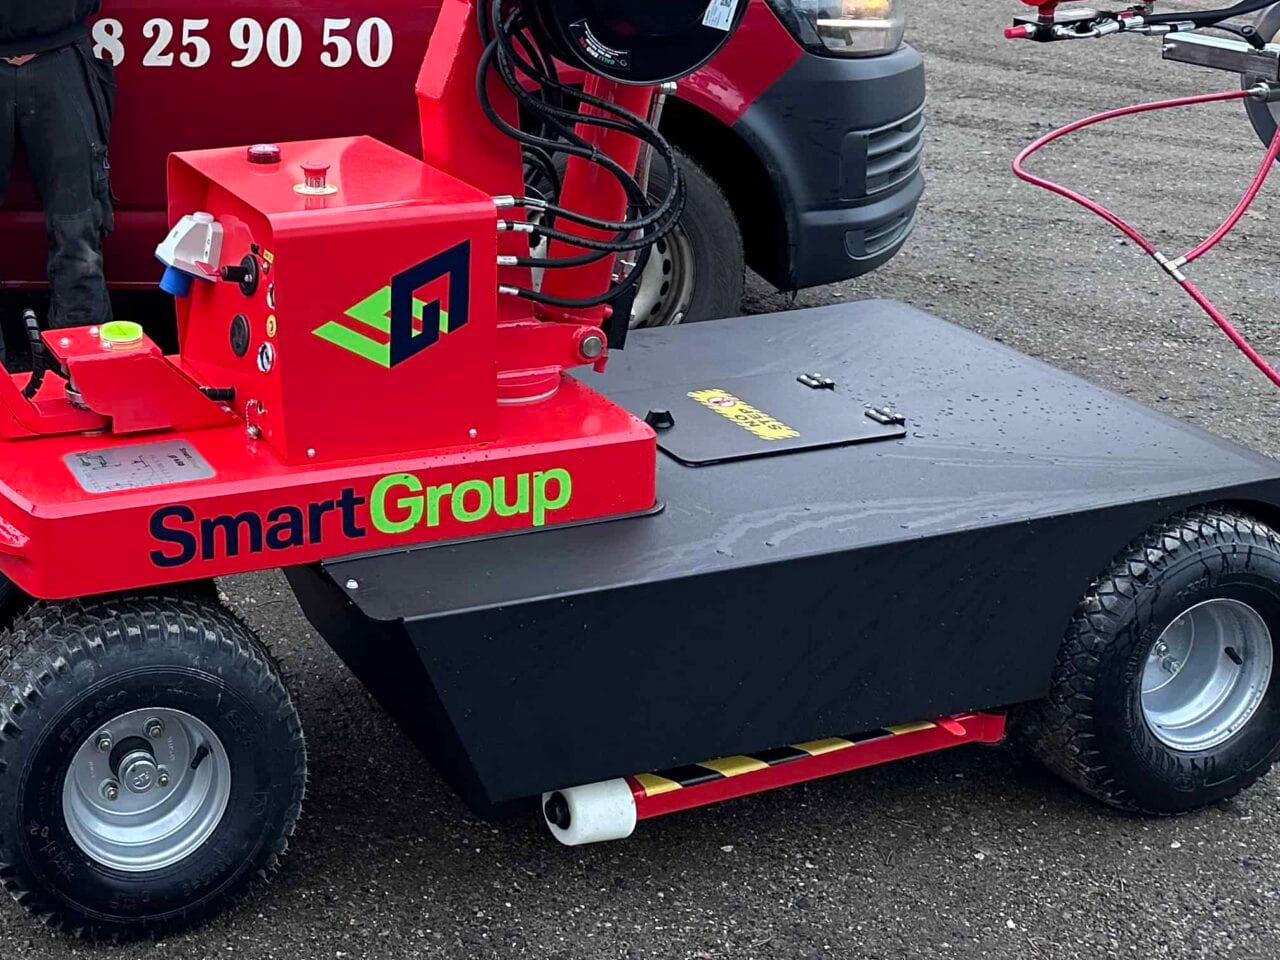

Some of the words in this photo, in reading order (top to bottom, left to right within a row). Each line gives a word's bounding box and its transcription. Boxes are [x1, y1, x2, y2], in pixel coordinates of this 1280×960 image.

[142, 17, 211, 68] 25
[229, 17, 302, 68] 90
[320, 17, 393, 68] 50
[738, 408, 783, 431] STEP
